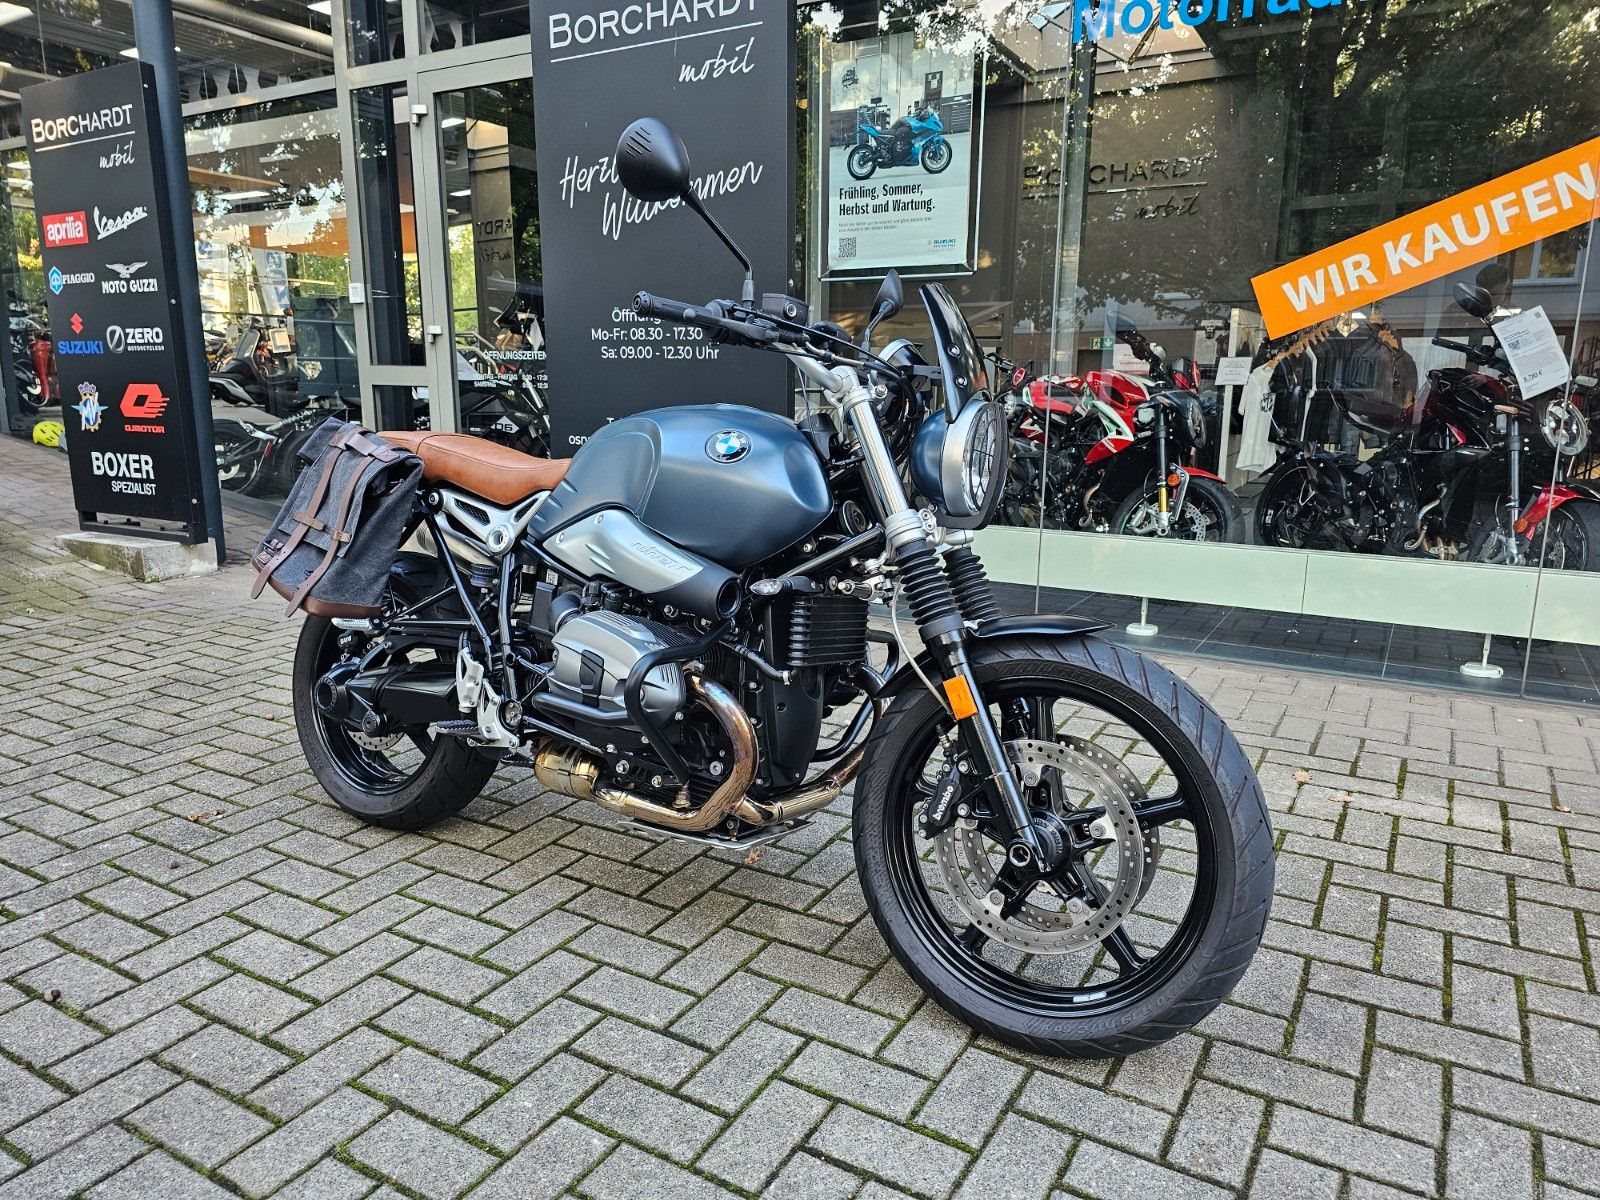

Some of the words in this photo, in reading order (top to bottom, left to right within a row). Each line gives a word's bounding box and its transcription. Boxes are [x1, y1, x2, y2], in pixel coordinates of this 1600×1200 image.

[678, 36, 755, 82] mobil
[31, 104, 133, 143] BORCHARDT
[99, 140, 135, 169] mobil
[1023, 157, 1205, 189] BOCHARDT
[839, 185, 880, 200] Frühling,
[882, 183, 924, 197] Sommer,
[839, 202, 870, 216] Herbst
[872, 200, 889, 213] und
[892, 198, 935, 213] Wartung.
[47, 217, 84, 244] aprilia
[93, 206, 148, 240] Vespa
[1280, 253, 1379, 313] WIR
[1382, 162, 1598, 276] KAUFEN
[62, 272, 95, 285] PIAGGIO
[101, 279, 127, 294] MOTO
[130, 278, 159, 293] GUZZI
[125, 327, 163, 344] ZERO
[630, 328, 663, 341] 08.30
[673, 327, 703, 340] 17.30
[57, 340, 104, 355] SUZUKI
[601, 346, 618, 359] Sa:
[620, 346, 653, 360] 09.00
[664, 346, 693, 359] 12.30
[696, 346, 719, 360] Uhr
[91, 451, 155, 480] BOXER
[111, 480, 157, 496] SPEZIALIST
[932, 785, 954, 821] brembo
